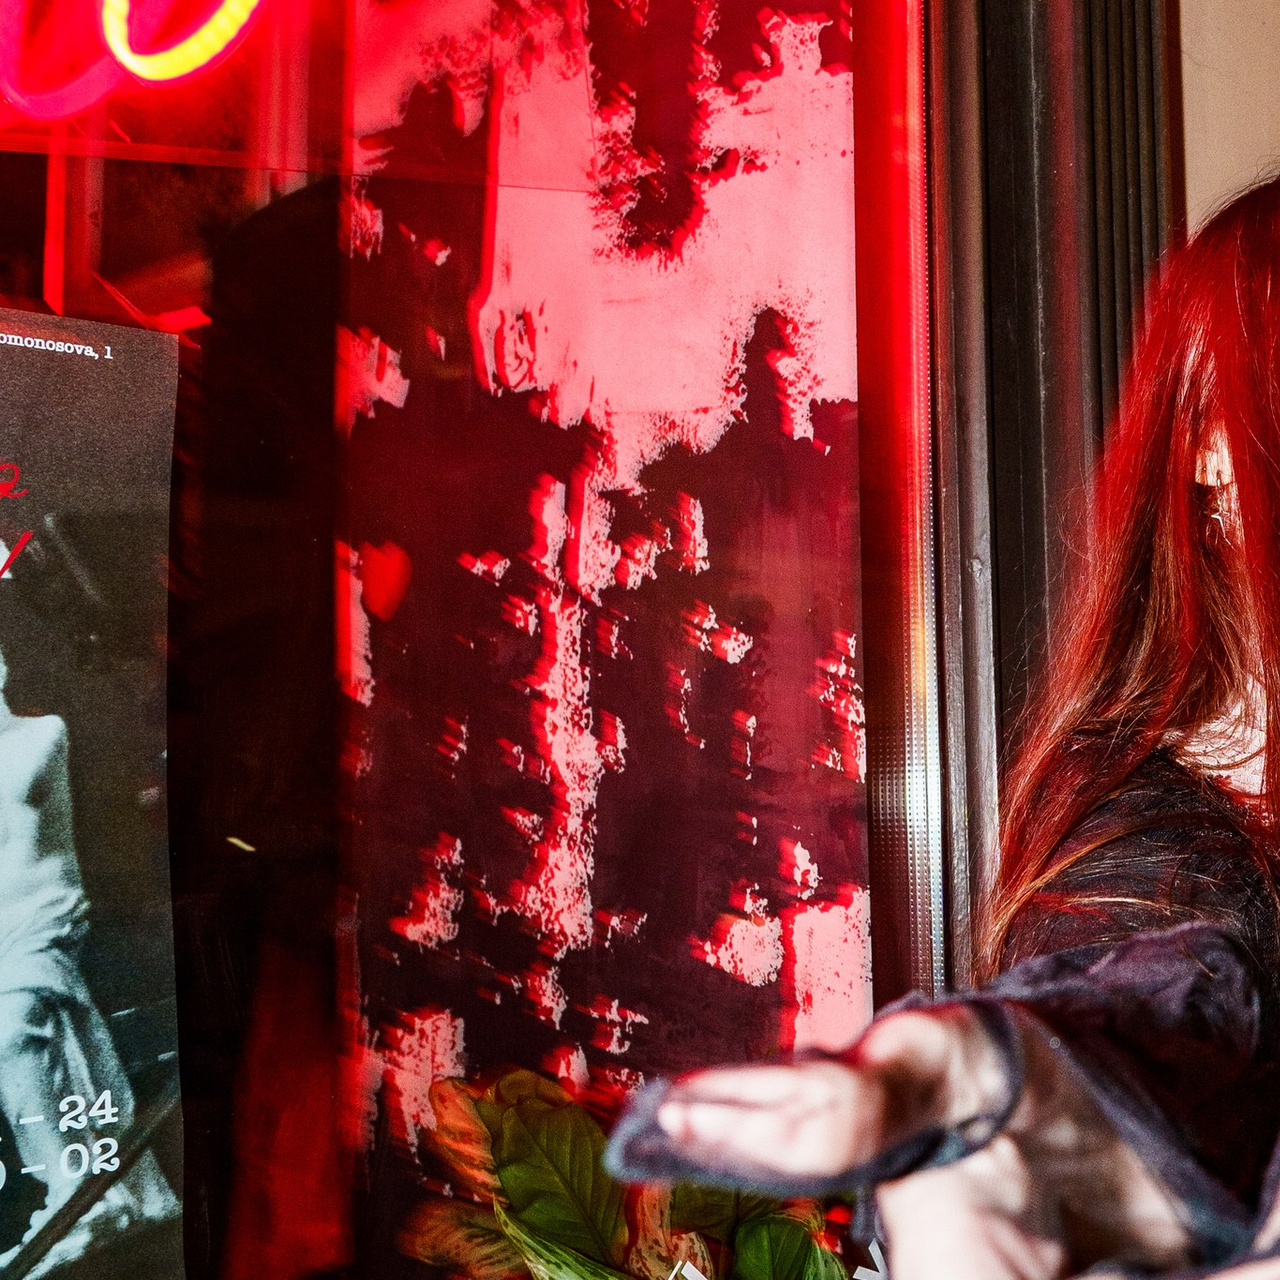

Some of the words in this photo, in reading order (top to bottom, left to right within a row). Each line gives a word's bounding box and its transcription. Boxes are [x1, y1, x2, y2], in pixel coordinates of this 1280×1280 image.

[104, 345, 113, 360] 1
[59, 1089, 119, 1132] 24
[60, 1137, 120, 1179] 02
